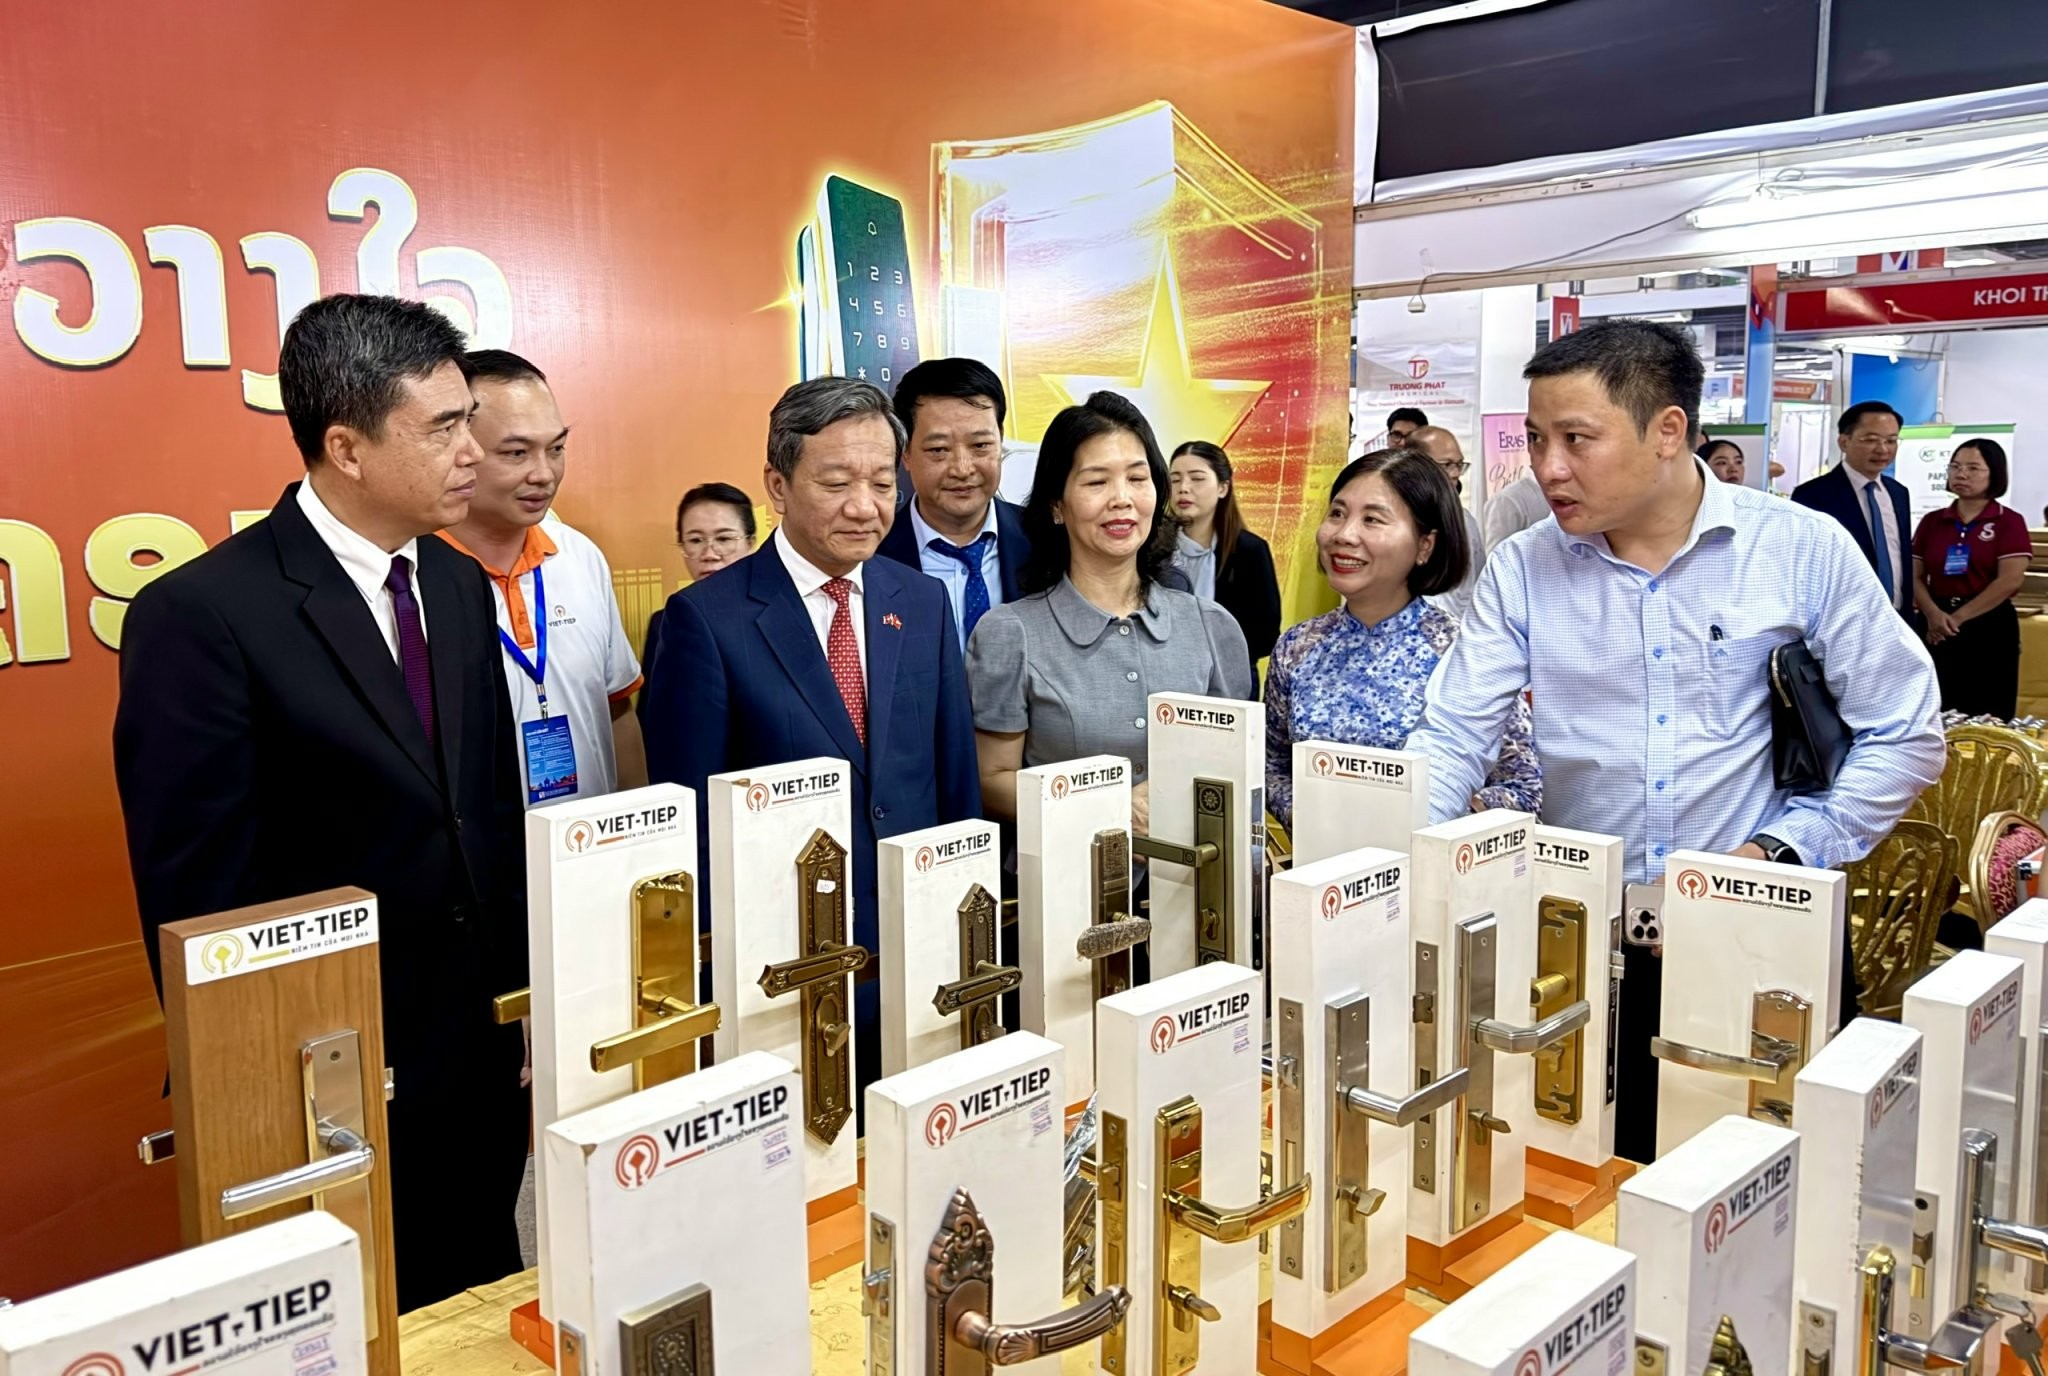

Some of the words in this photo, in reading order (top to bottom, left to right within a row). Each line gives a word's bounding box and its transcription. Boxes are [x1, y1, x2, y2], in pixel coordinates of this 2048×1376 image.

[847, 261, 853, 277] 1
[870, 265, 879, 281] 2
[894, 270, 903, 285] 3
[849, 297, 860, 312] 4
[874, 301, 884, 315] 5
[897, 304, 906, 318] 6
[1973, 286, 2026, 306] KHOI
[853, 331, 862, 347] 7
[878, 334, 887, 349] 8
[901, 337, 910, 351] 9
[881, 367, 890, 382] 0
[1176, 707, 1235, 726] VIET-TIEP
[1070, 766, 1124, 787] VIET-TIEP
[1336, 756, 1404, 778] VIET-TIEP
[772, 772, 840, 796] VIET-TIEP
[596, 805, 677, 835] VIET-TIEP
[936, 832, 991, 858] VIET-TIEP
[1475, 828, 1526, 858] VIET-TIEP
[1534, 842, 1590, 863] T-TIEP
[1343, 867, 1401, 900] VIET-TIEP
[1711, 875, 1812, 904] VIET-TIEP
[248, 907, 369, 950] VIET-TIEP
[1178, 992, 1250, 1032] VIET-TIEP
[960, 1067, 1050, 1119] VIET-TIEP
[664, 1085, 788, 1153] VIET-TIEP
[1729, 1154, 1792, 1220] VIET-TIEP
[132, 1279, 332, 1372] VIET-TIEP
[1544, 1283, 1626, 1368] VIET-TIEP
